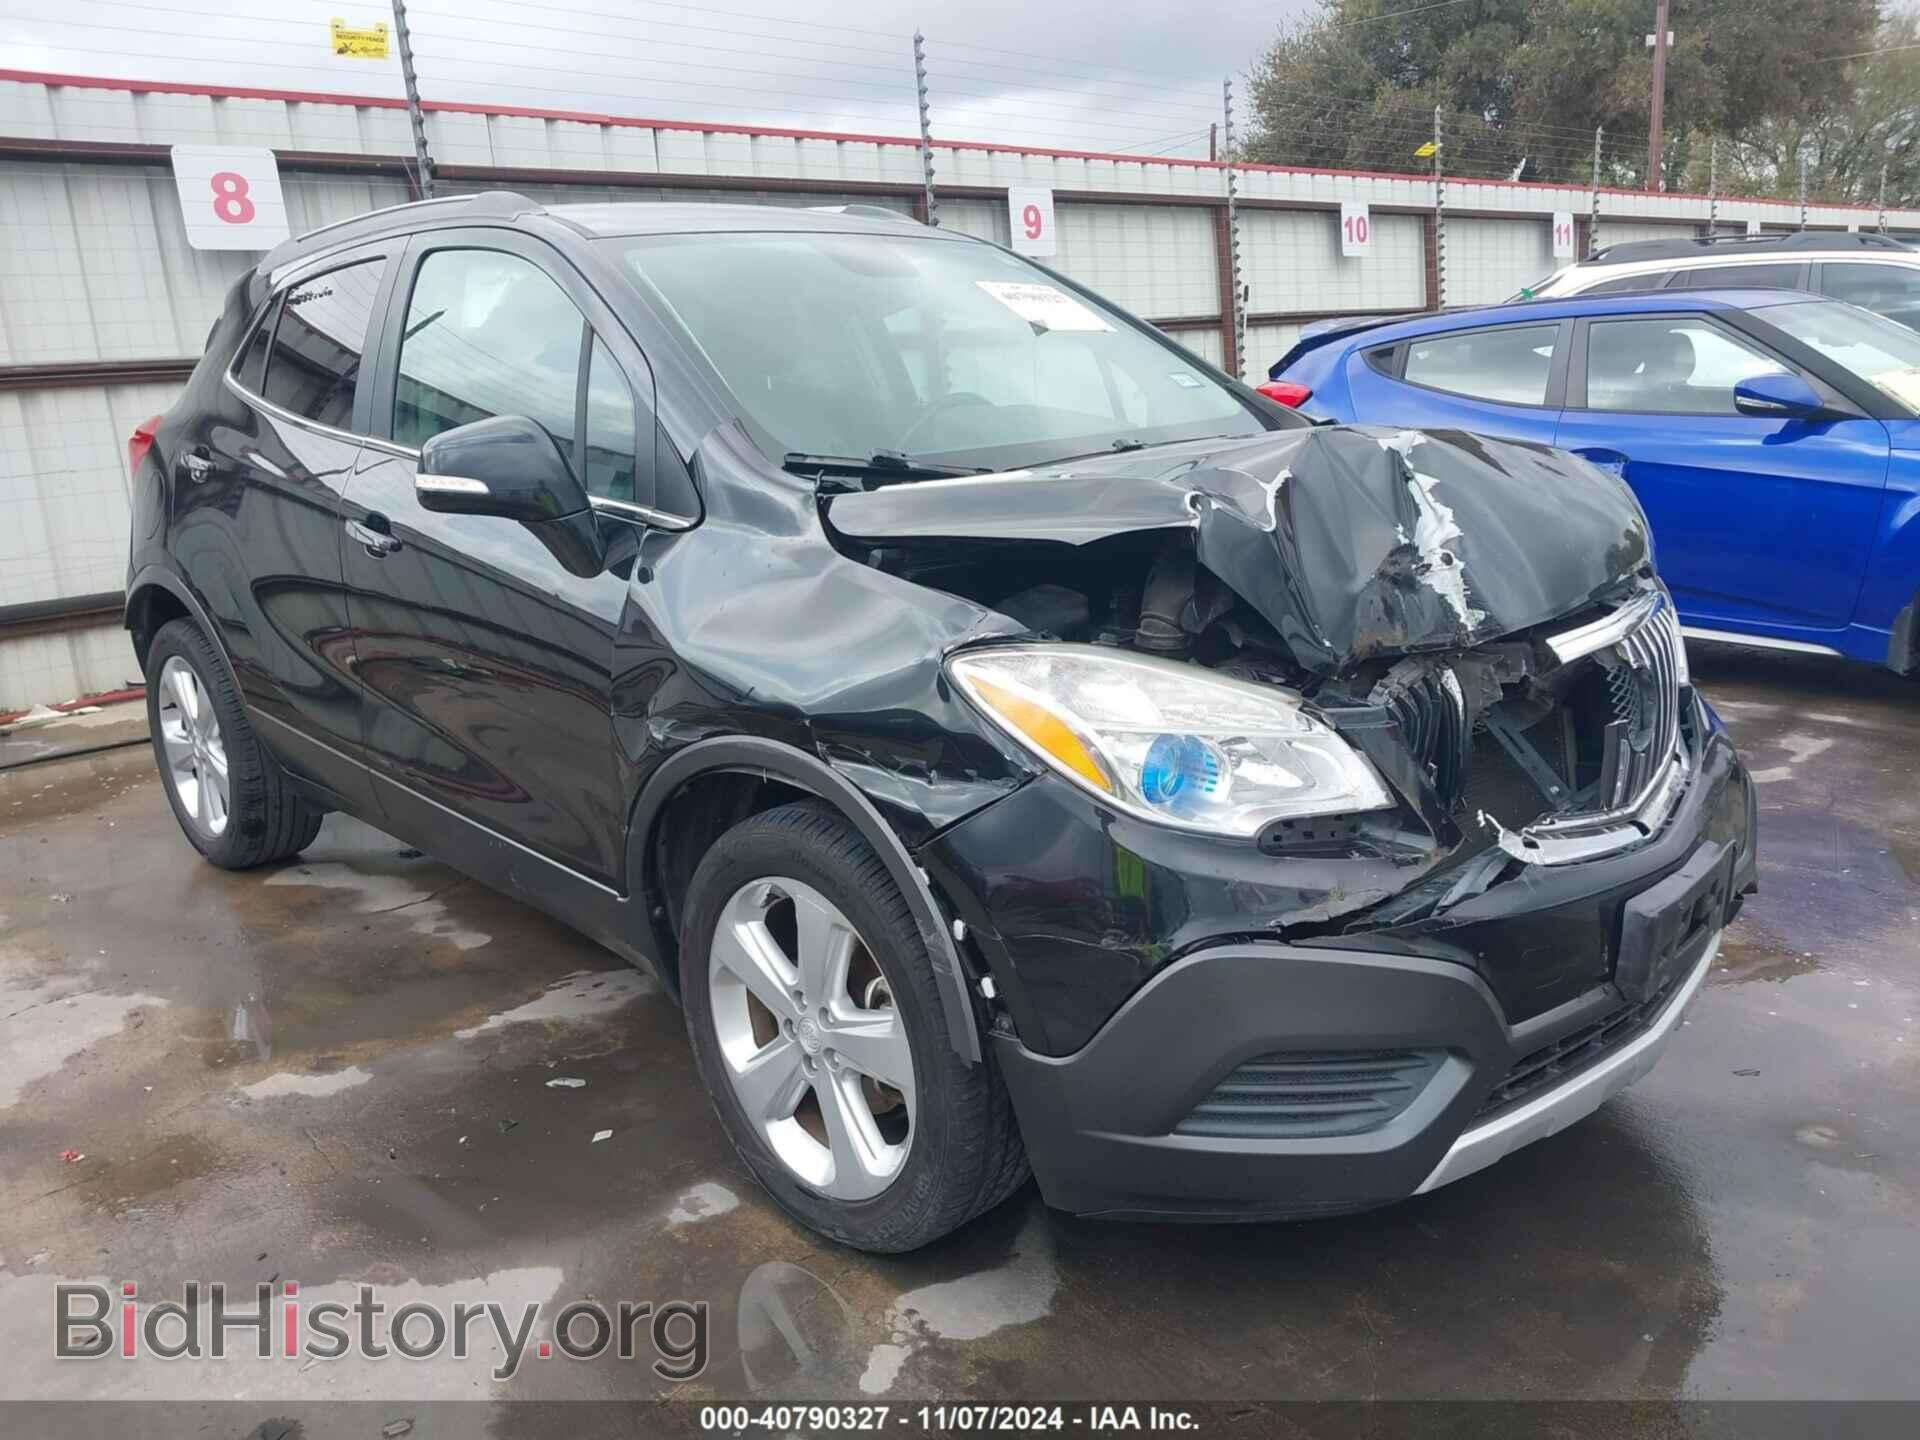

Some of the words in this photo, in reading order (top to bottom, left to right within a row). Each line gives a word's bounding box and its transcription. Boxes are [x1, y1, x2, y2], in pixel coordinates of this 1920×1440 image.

[211, 172, 255, 224] 8
[1023, 204, 1041, 240] 9
[1344, 215, 1367, 243] 10
[1555, 223, 1570, 246] 11
